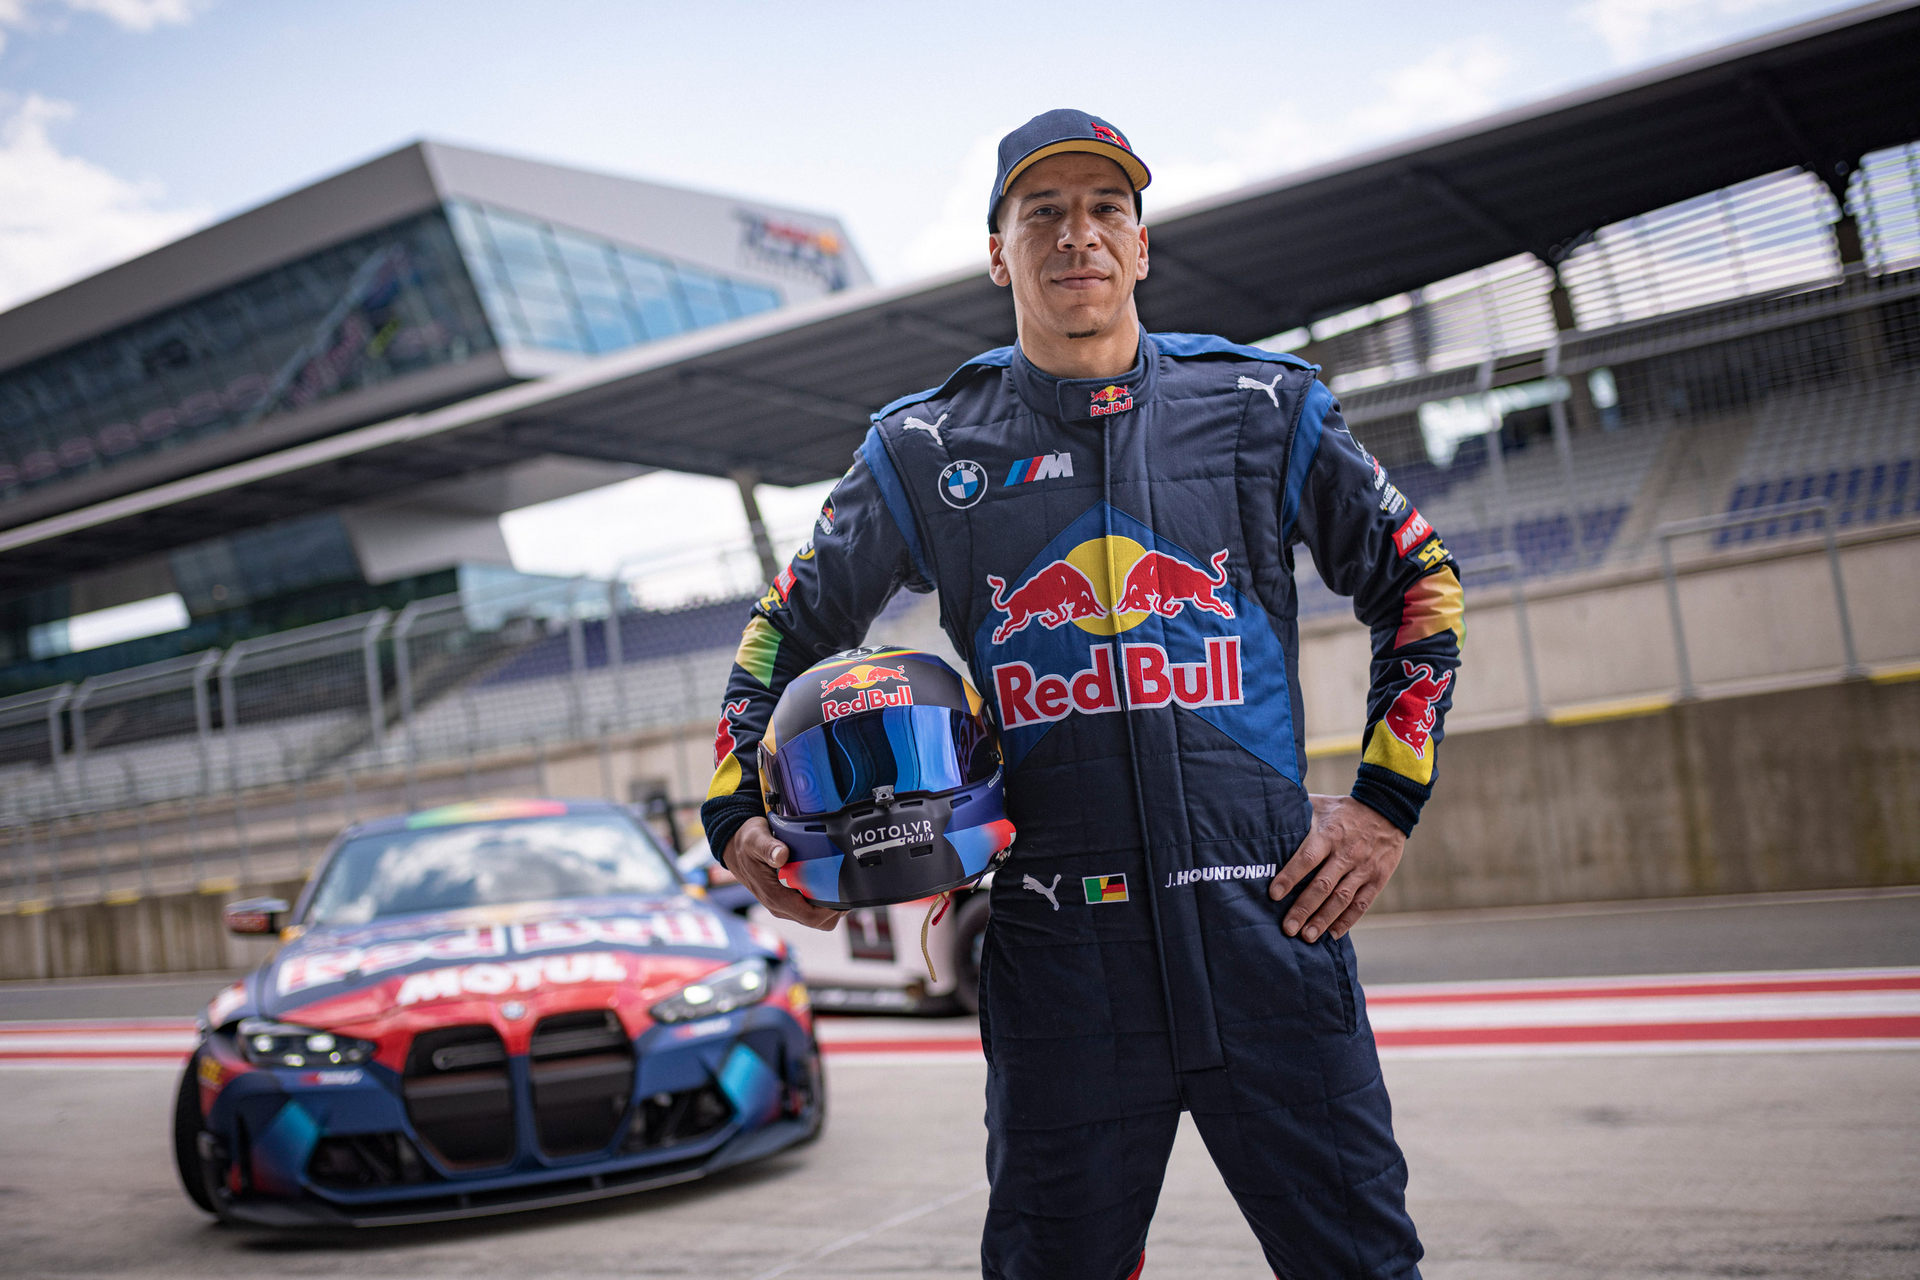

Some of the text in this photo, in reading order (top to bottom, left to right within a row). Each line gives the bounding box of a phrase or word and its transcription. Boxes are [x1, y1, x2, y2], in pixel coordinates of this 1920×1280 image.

[1090, 397, 1133, 417] Red Bull
[943, 462, 979, 479] BMW
[1401, 513, 1429, 550] MOT
[992, 636, 1244, 731] Red Bull
[822, 685, 913, 722] Red Bull
[850, 820, 932, 846] MOTOLVR
[1165, 863, 1277, 888] J.HOUNTONDJI
[396, 952, 627, 1006] MOTUL
